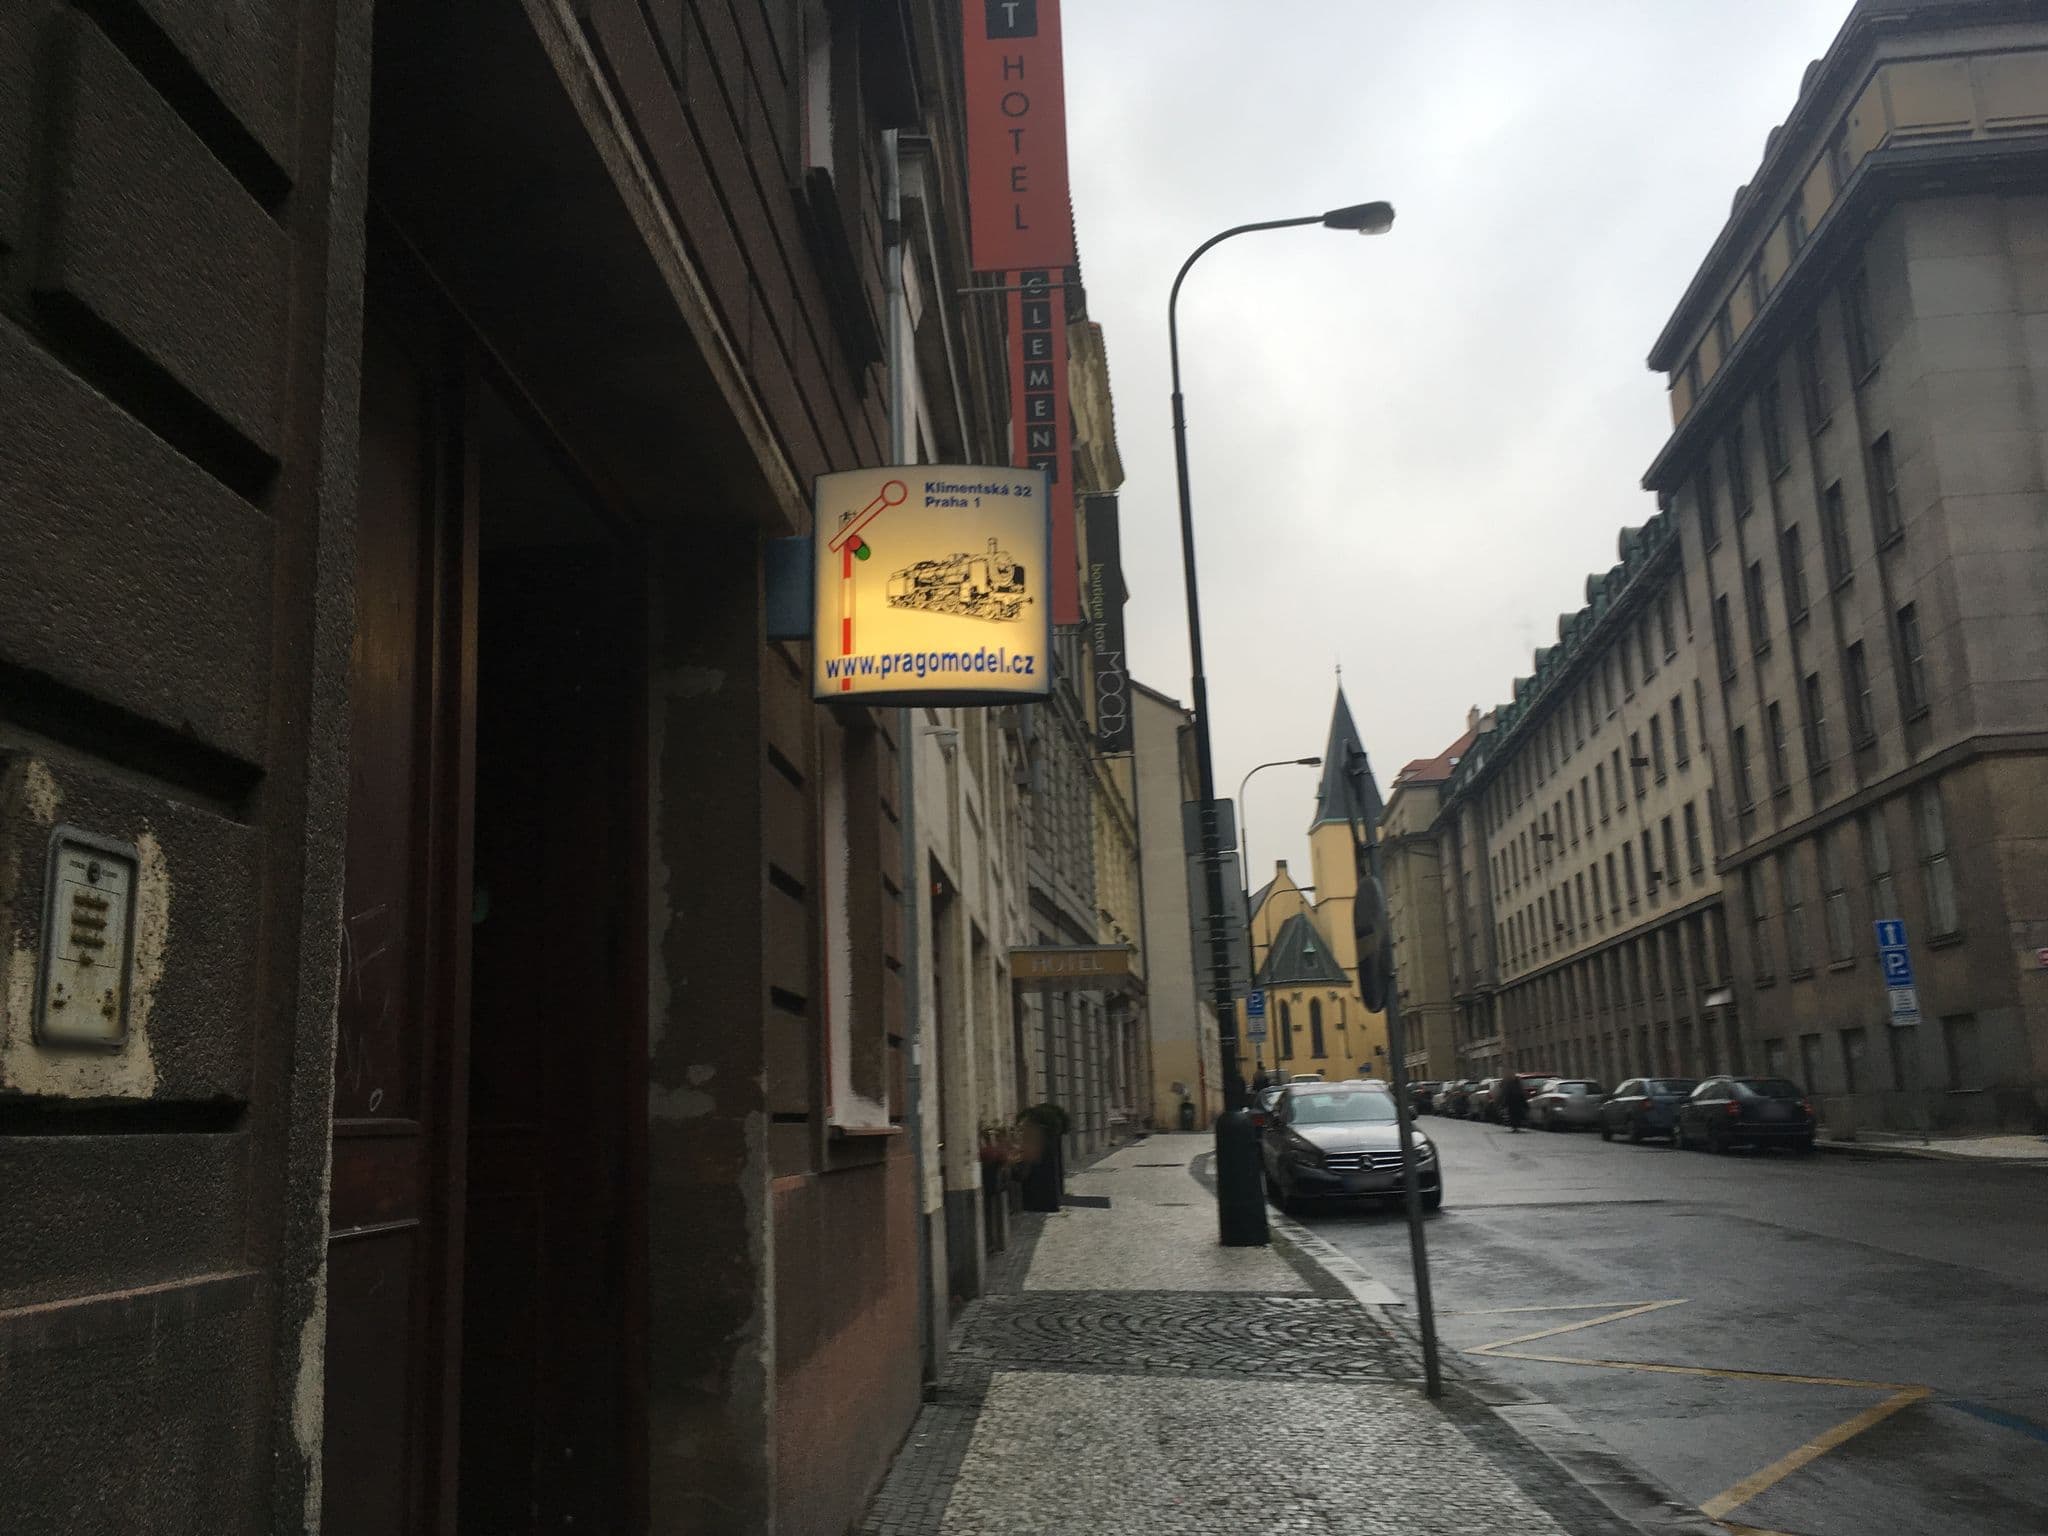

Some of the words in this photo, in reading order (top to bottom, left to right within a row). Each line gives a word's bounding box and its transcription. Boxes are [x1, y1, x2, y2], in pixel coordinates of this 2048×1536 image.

[1001, 55, 1030, 230] HOTEL
[925, 482, 1009, 496] Klimentská
[1014, 485, 1033, 497] 32
[925, 496, 968, 508] Praha
[974, 496, 981, 508] 1
[826, 647, 1035, 680] www.pragomodel.cz
[1887, 953, 1905, 976] P
